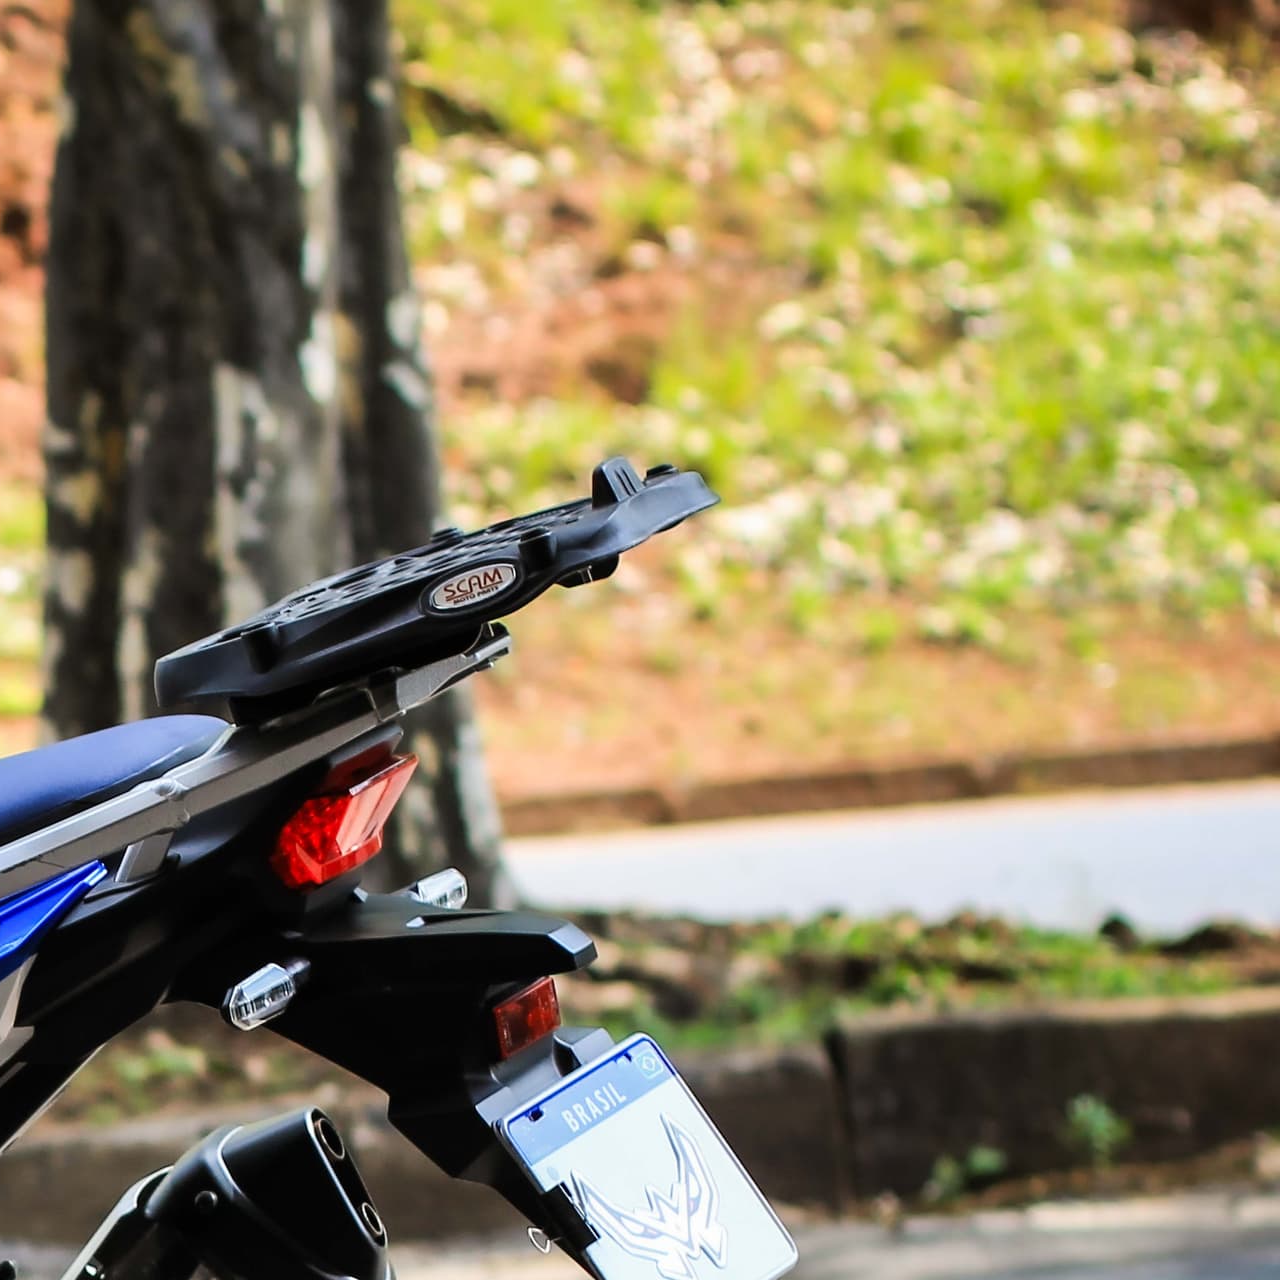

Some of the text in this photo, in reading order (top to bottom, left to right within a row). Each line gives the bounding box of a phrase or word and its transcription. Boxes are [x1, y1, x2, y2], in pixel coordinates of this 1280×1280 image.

[444, 568, 502, 600] SCAM
[453, 594, 476, 604] MOTO
[560, 1082, 627, 1133] BRASIL
